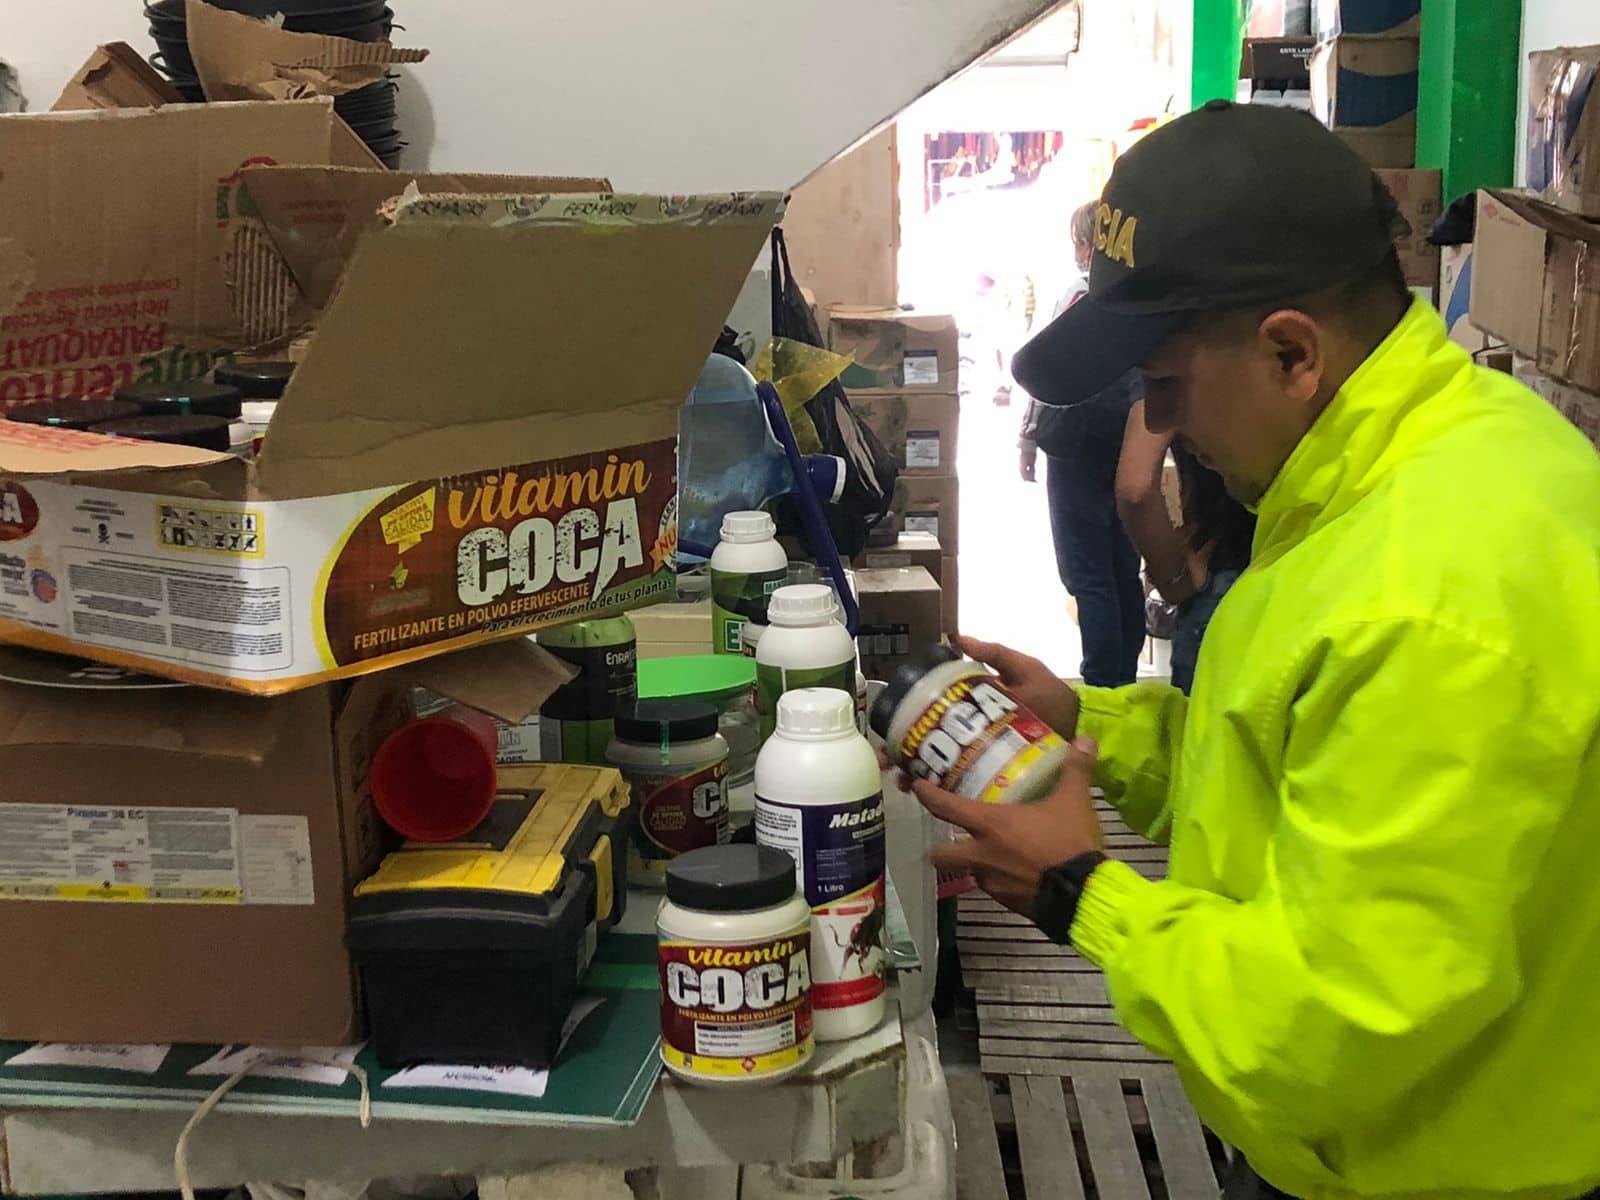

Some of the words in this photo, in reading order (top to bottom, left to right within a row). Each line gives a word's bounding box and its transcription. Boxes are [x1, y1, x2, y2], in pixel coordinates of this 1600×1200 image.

[0, 321, 168, 372] PARAQUAT
[456, 496, 645, 607] COCA
[353, 615, 446, 651] FERTILIZANTE
[447, 611, 466, 629] EN
[467, 602, 509, 626] POLVO
[510, 582, 590, 616] EFERVESCENTE
[524, 599, 599, 624] crecimiento
[599, 592, 613, 608] de
[614, 588, 632, 604] tus
[633, 578, 672, 602] plantas
[824, 883, 845, 893] Litro
[667, 947, 812, 1014] COCA
